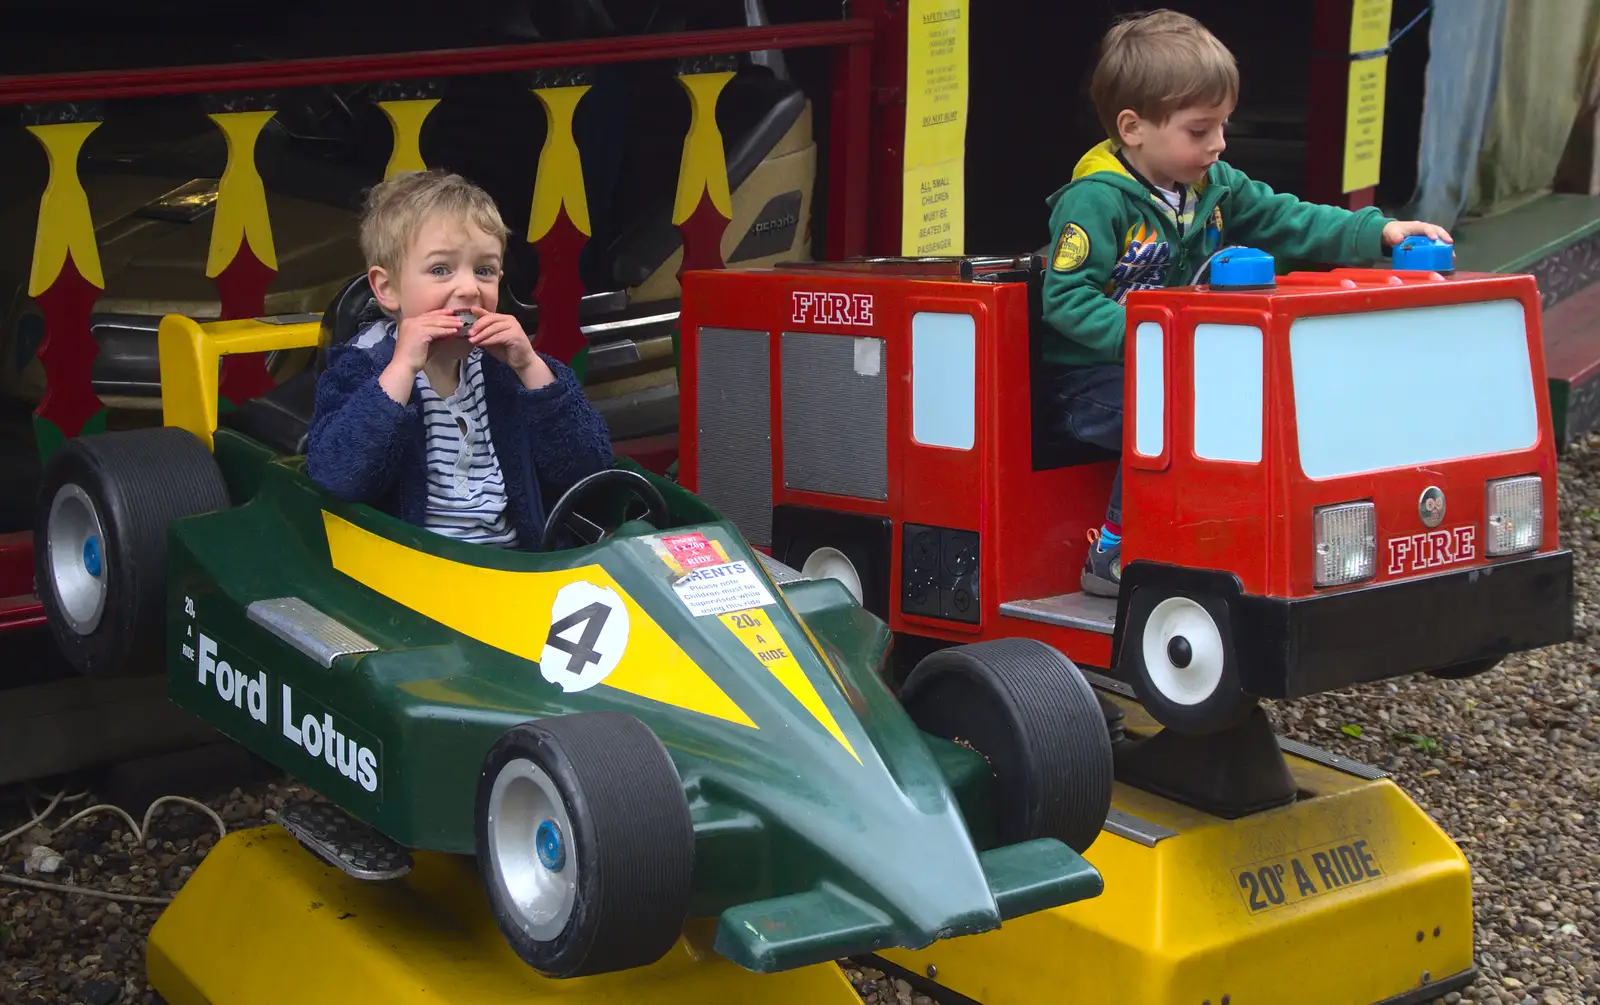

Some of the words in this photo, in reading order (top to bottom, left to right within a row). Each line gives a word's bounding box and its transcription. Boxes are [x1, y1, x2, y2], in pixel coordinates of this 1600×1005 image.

[921, 181, 931, 193] ALL
[933, 178, 949, 188] SMALL
[922, 192, 949, 206] CHILDREN
[923, 210, 938, 222] MUST
[940, 208, 947, 218] BE
[919, 224, 941, 238] SEATED
[917, 238, 951, 255] PASSENGER
[792, 291, 873, 326] FIRE
[1388, 526, 1475, 574] FIRE
[686, 555, 714, 565] RIDE
[687, 563, 746, 582] RENTS
[684, 590, 720, 600] Children
[722, 586, 743, 595] must
[689, 582, 718, 591] Please
[690, 595, 737, 607] supervised
[737, 591, 760, 599] while
[701, 605, 726, 613] using
[743, 599, 761, 607] ride
[731, 614, 762, 629] 20p
[187, 625, 192, 637] A
[545, 601, 612, 675] 4
[756, 634, 767, 643] A
[182, 643, 195, 661] RIDE
[758, 648, 788, 661] RIDE
[199, 632, 267, 725] Ford
[283, 683, 378, 792] Lotus
[1291, 858, 1317, 896] A
[1312, 840, 1381, 889] RIDE
